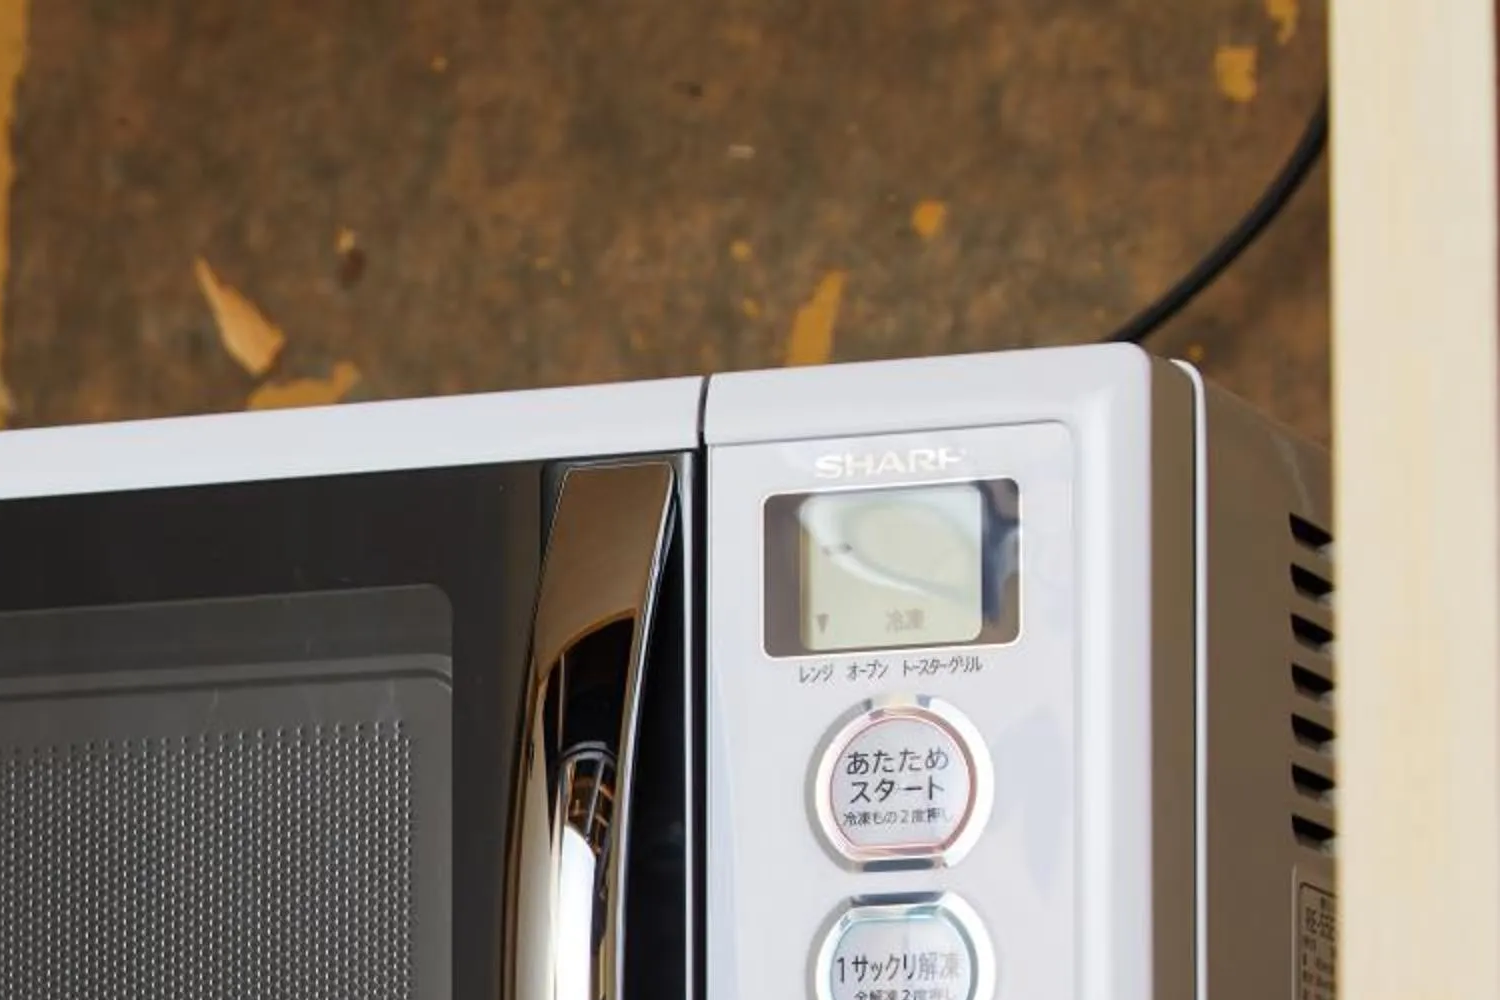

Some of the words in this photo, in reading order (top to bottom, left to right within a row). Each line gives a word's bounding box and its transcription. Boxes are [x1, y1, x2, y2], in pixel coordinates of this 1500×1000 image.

[799, 663, 835, 684] レンジ
[846, 658, 889, 681] オーブン
[845, 748, 948, 776] あたため
[850, 776, 946, 804] スタート
